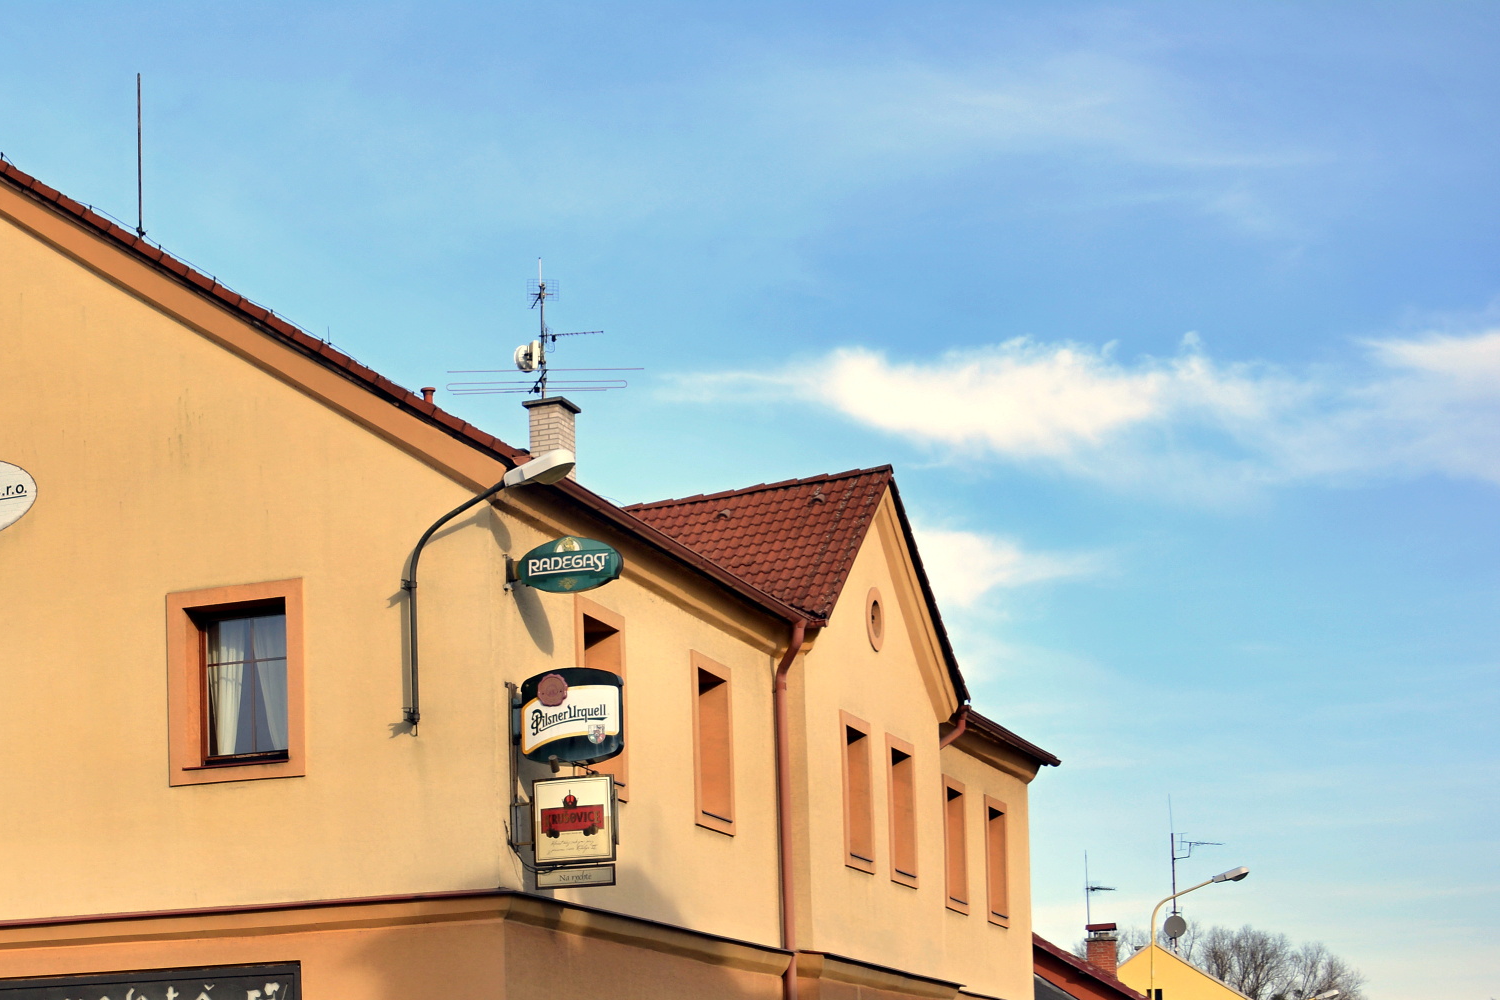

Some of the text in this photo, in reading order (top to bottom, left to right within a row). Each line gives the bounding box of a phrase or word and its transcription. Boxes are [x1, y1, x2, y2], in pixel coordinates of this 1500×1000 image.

[528, 553, 608, 576] RADEGAST
[531, 704, 606, 736] Pilsner Urquell
[545, 810, 601, 827] KRUŠOVICE
